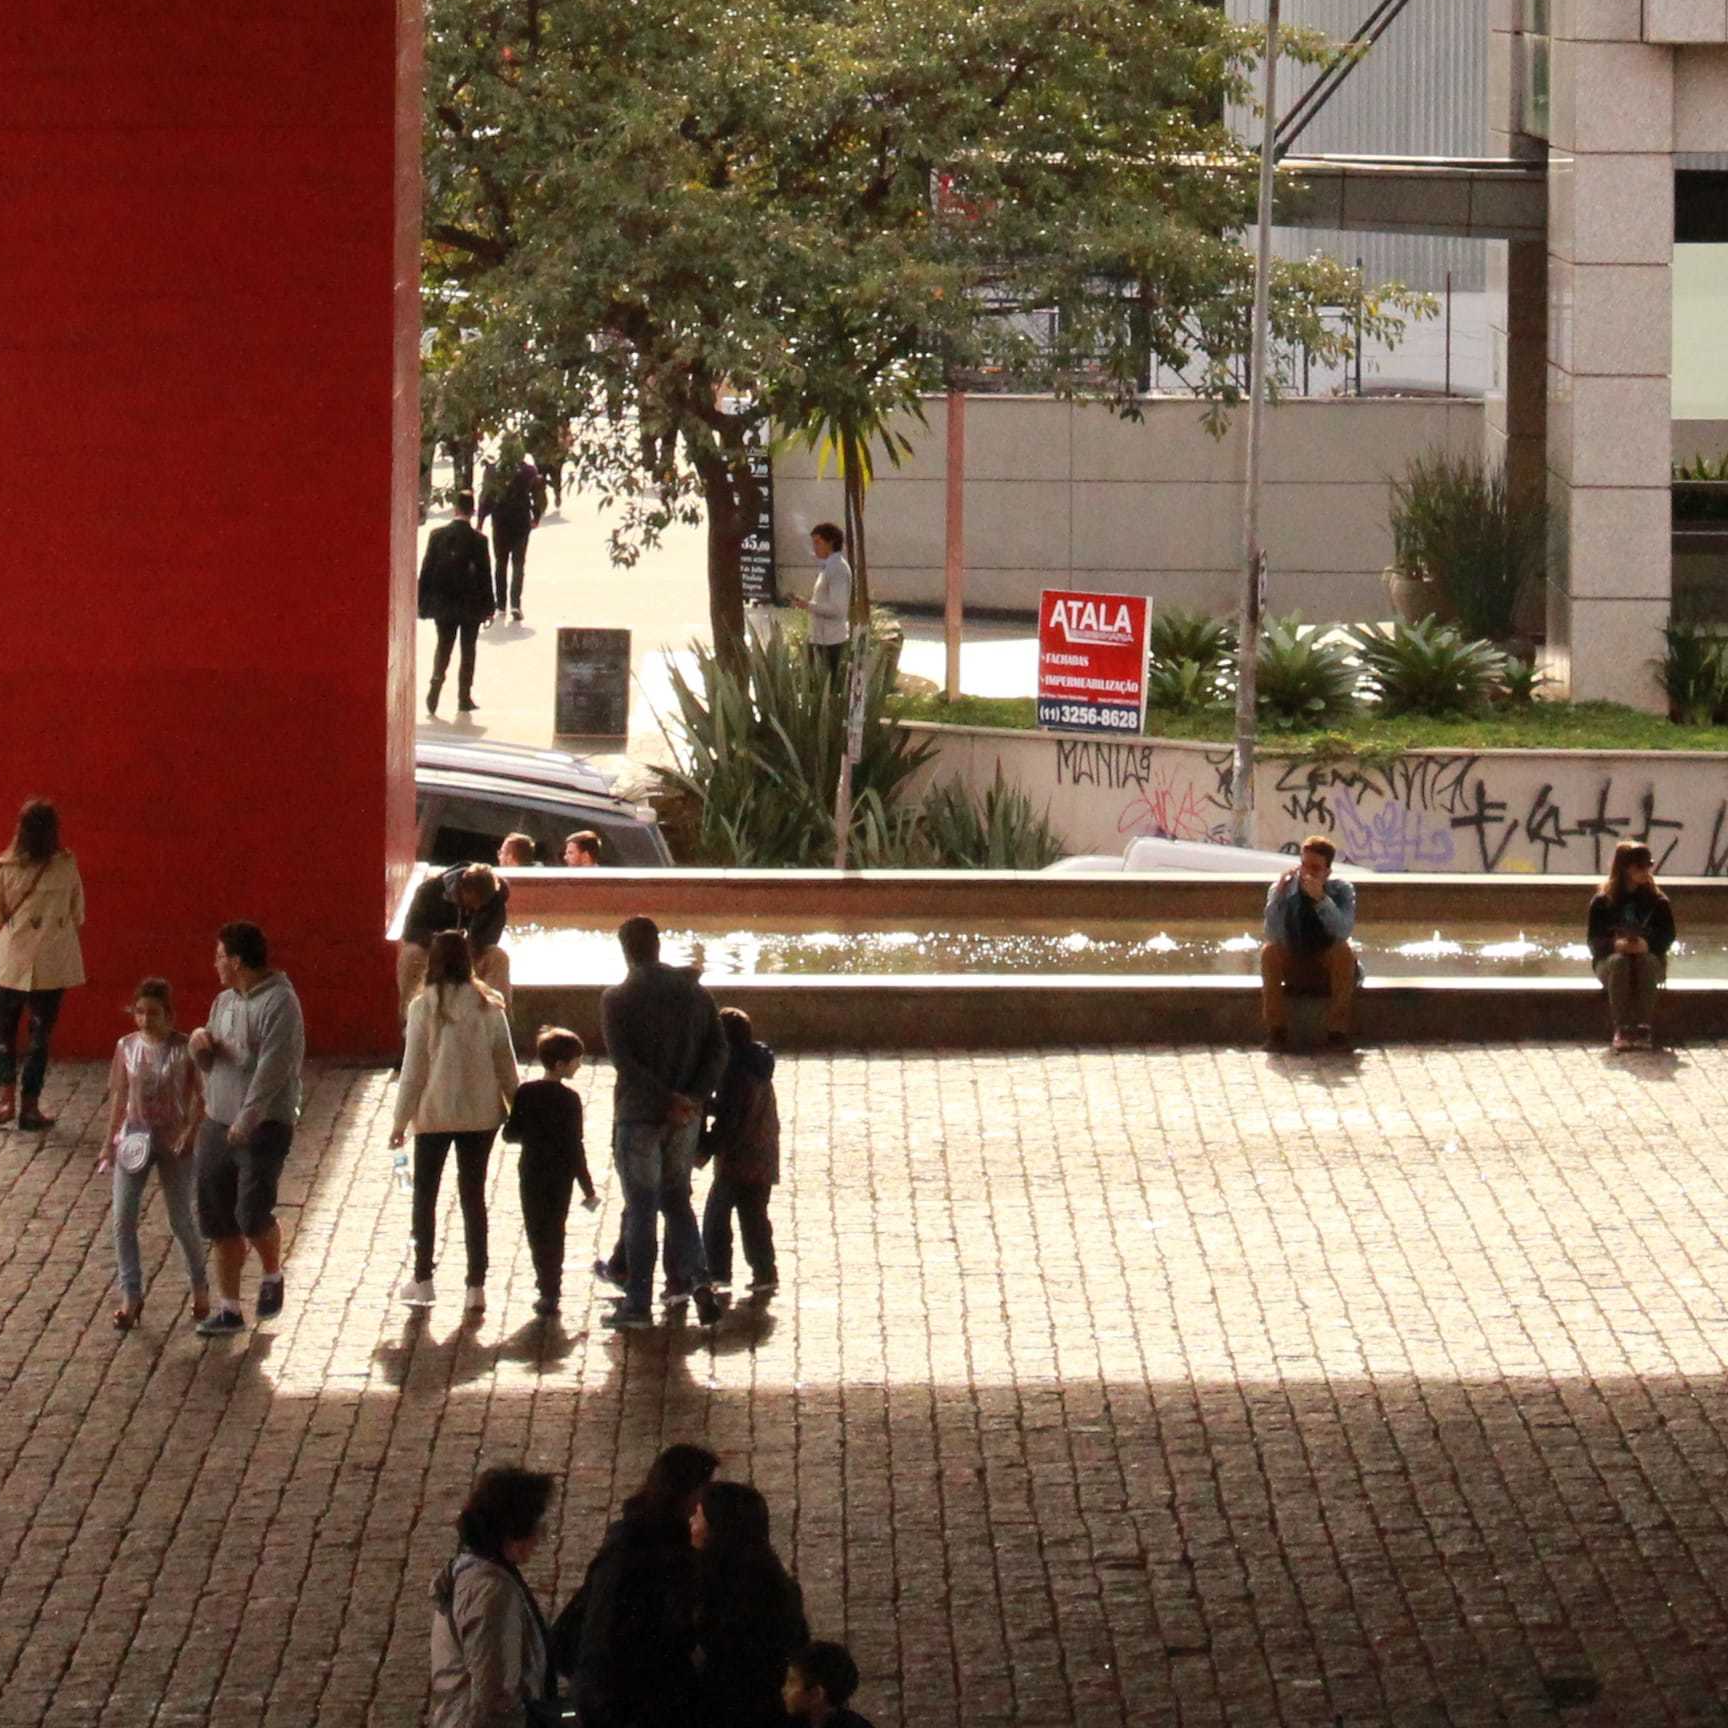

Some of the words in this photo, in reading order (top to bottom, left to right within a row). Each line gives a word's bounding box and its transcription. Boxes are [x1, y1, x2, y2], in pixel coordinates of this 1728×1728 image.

[1049, 599, 1133, 635] ATALA
[1045, 652, 1090, 667] FACHADAS
[1045, 674, 1139, 694] IMPERMEABILIZAÇÃO
[1040, 704, 1061, 723] (11)
[1061, 705, 1138, 729] 3256-8628
